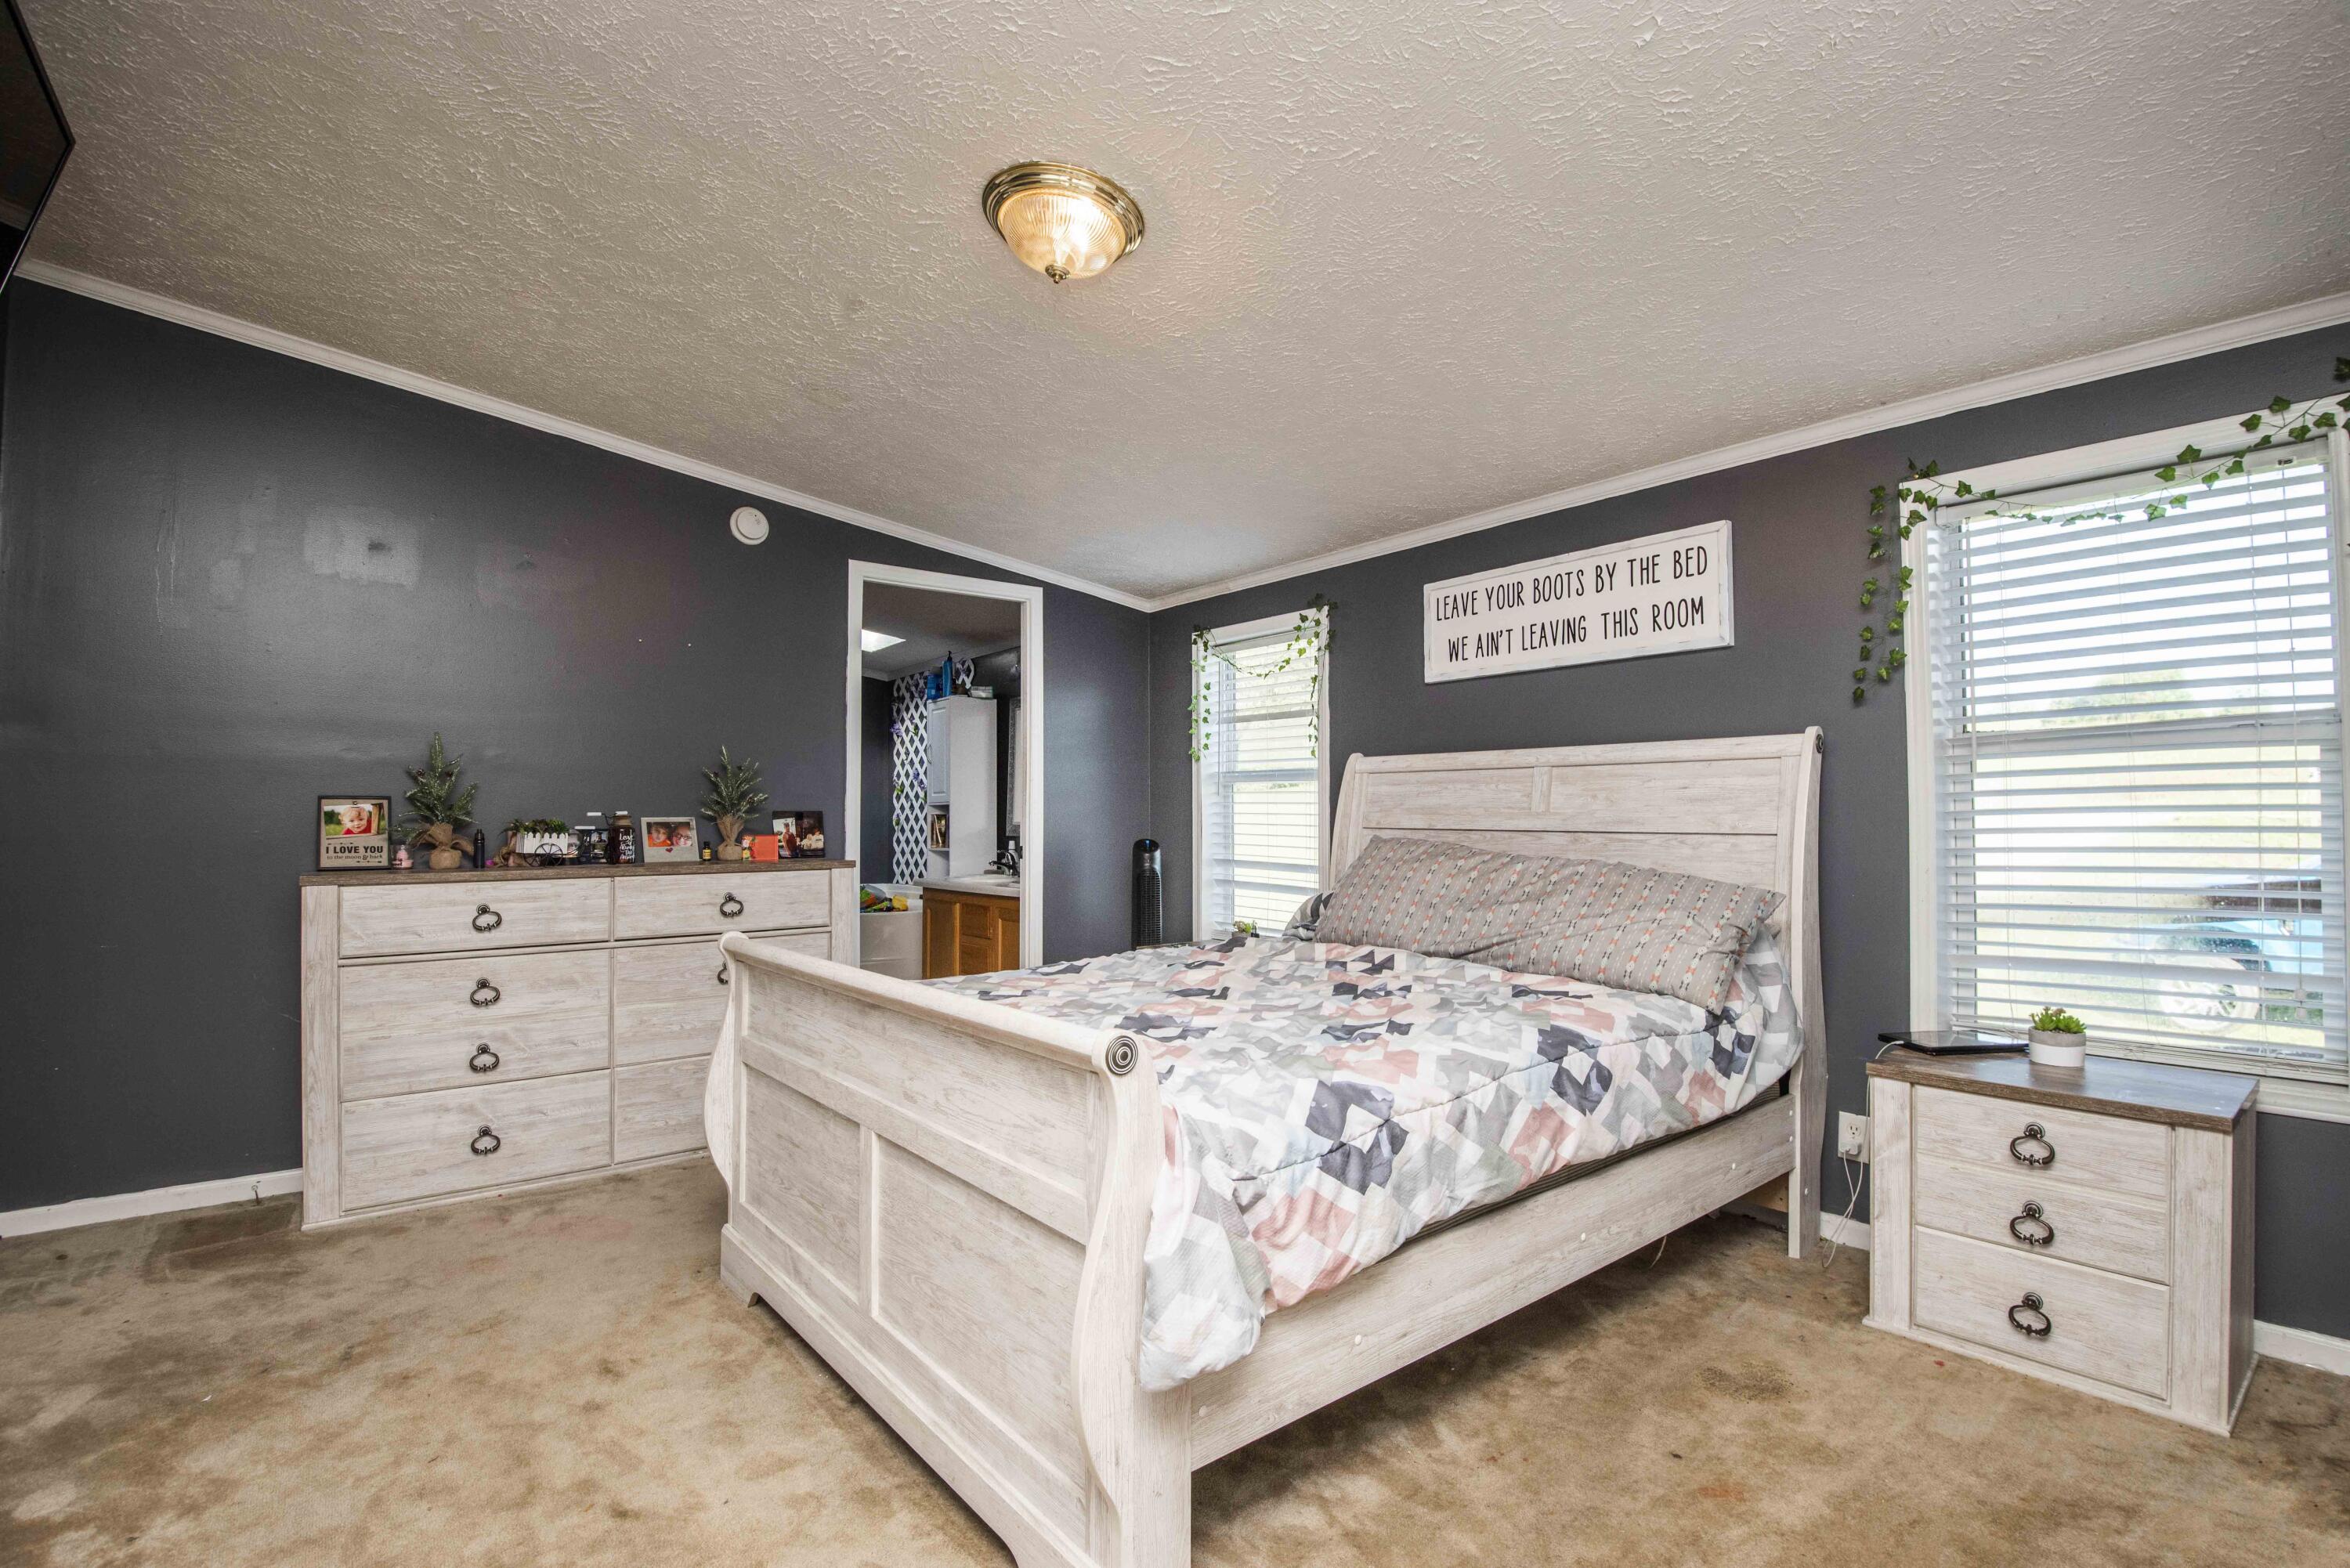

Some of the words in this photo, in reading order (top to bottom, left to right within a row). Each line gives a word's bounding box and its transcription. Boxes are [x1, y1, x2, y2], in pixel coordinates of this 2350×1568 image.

[1436, 590, 1478, 621] LEAVE
[1485, 580, 1524, 612] YOUR
[1533, 569, 1585, 603] BOOTS
[1595, 562, 1616, 593] BY
[1627, 554, 1661, 587] THE
[1673, 546, 1708, 579] BED
[1448, 636, 1468, 663] WE
[1475, 629, 1513, 658] AIN'T
[1521, 616, 1586, 651] LEAVING
[1600, 607, 1639, 639] THIS
[1651, 596, 1705, 632] ROOM
